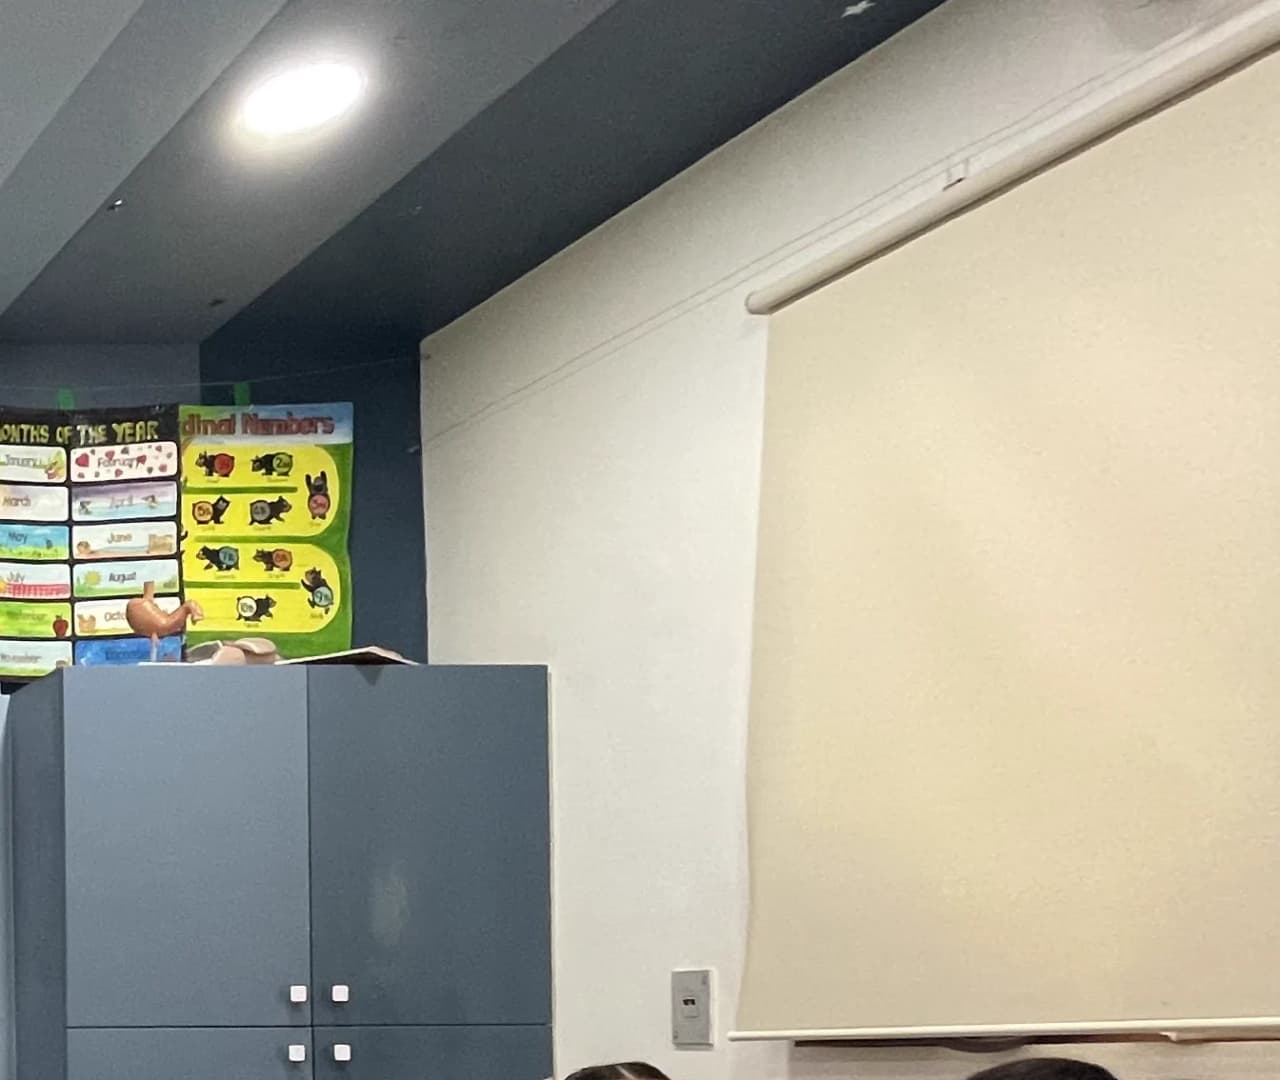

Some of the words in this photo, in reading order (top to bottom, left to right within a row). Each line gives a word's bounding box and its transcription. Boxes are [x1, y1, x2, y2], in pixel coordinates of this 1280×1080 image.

[241, 411, 336, 435] Numbers
[56, 426, 73, 443] OF
[77, 424, 108, 446] THE
[112, 421, 159, 442] YEAR
[8, 531, 28, 544] May
[107, 533, 133, 544] June
[109, 572, 137, 584] August
